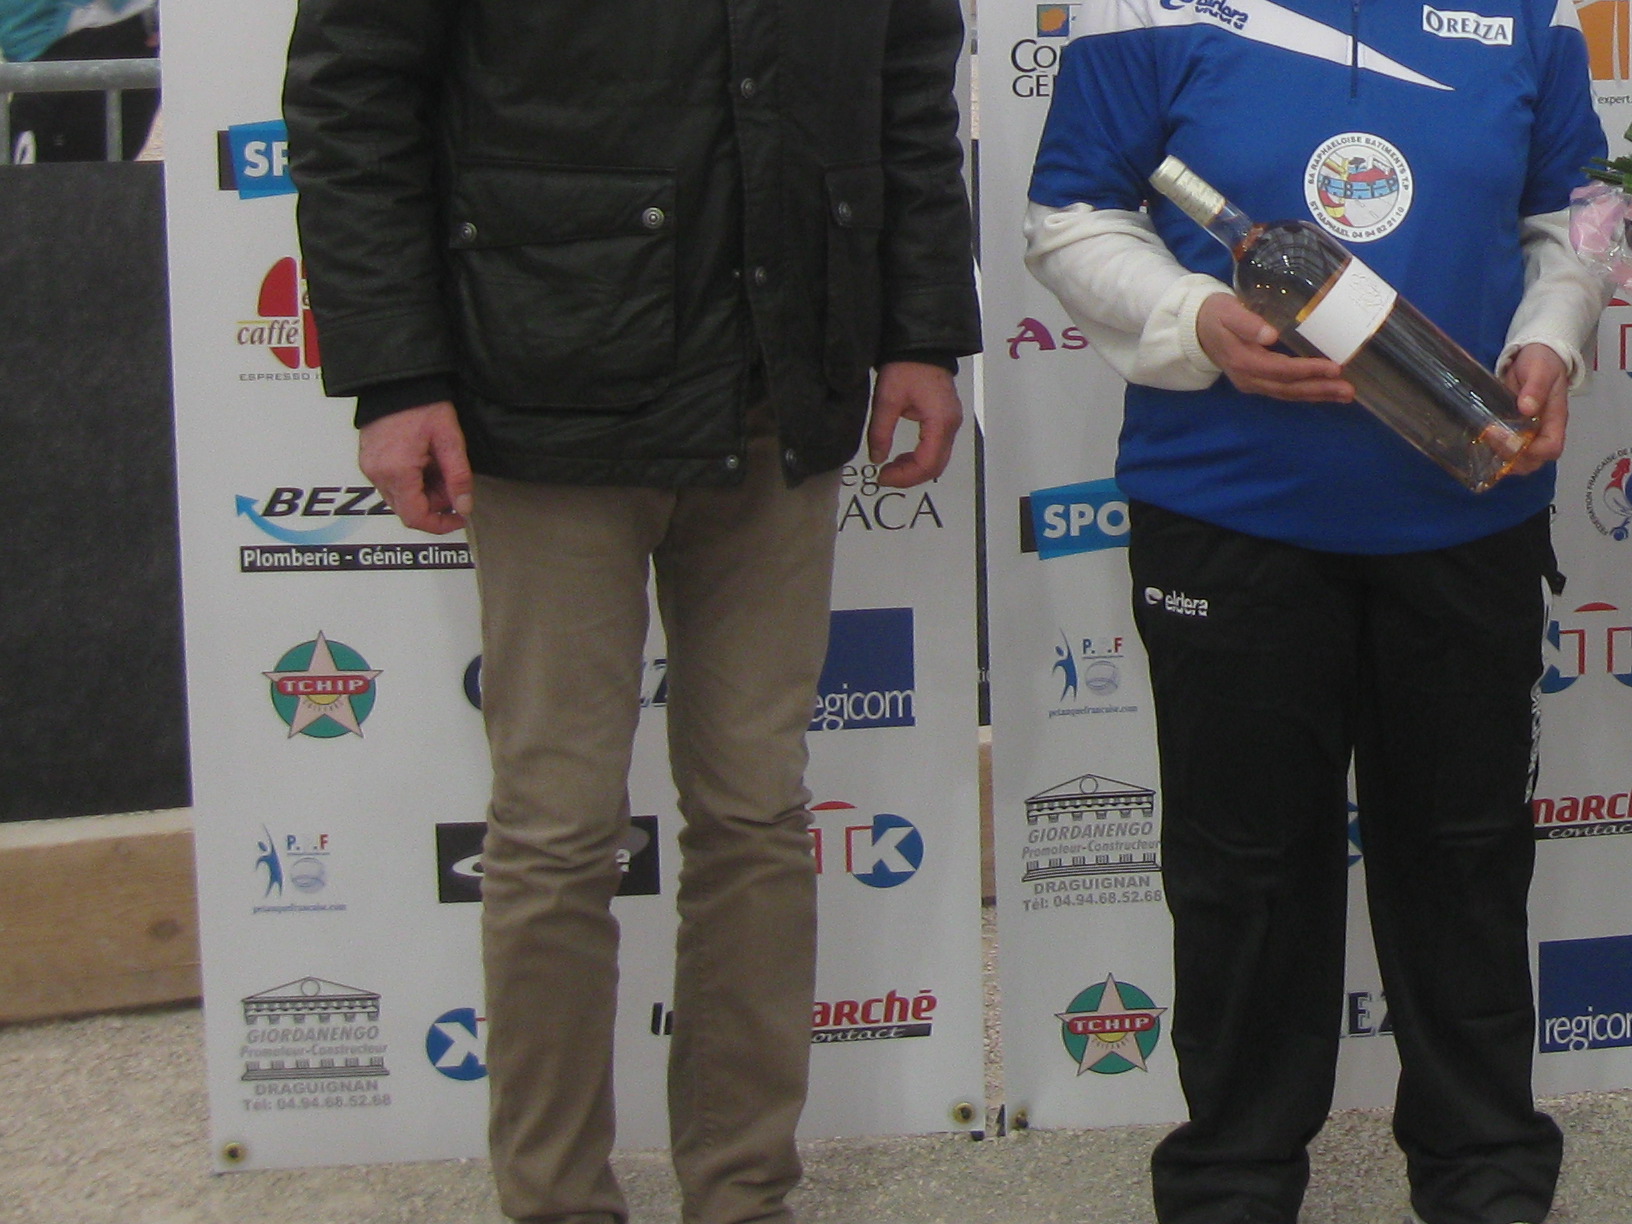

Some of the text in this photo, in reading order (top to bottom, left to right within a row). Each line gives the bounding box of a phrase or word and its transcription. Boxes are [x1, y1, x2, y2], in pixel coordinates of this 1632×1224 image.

[1424, 9, 1509, 42] OREZZA
[237, 320, 299, 346] caffé
[239, 372, 312, 382] ESPRESSO
[838, 492, 943, 532] ACA
[1043, 500, 1131, 540] SPO
[243, 547, 340, 567] Plomberie
[359, 545, 414, 566] Génie
[1164, 589, 1209, 617] eldera
[282, 679, 366, 693] TCHIP
[810, 684, 915, 731] egicom
[1028, 821, 1154, 844] GIORDANENGO
[1034, 875, 1151, 895] DRAGUIGNAN
[1053, 889, 1163, 908] 04.94.68.52.68
[246, 1025, 380, 1045] GIORDANENGO
[811, 1025, 906, 1043] ontact
[1074, 1017, 1150, 1032] TCHIP
[255, 1079, 379, 1096] DRAGUIGNAN
